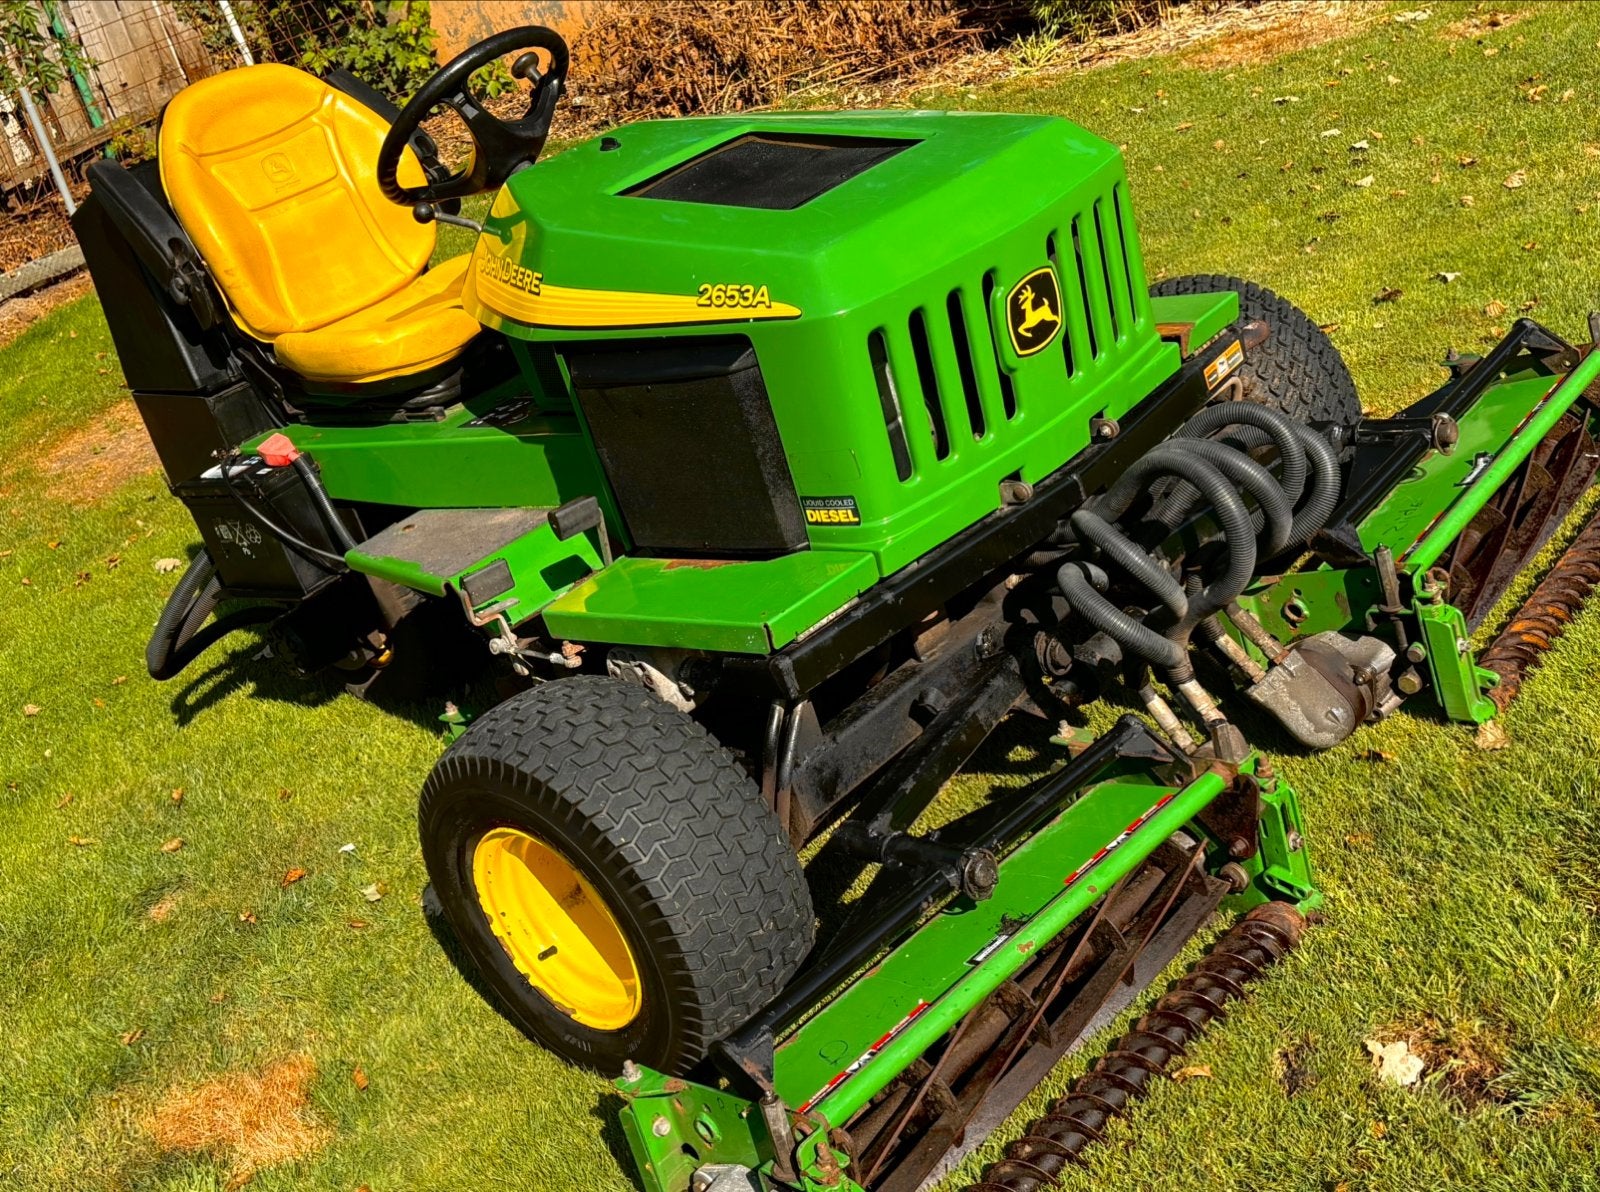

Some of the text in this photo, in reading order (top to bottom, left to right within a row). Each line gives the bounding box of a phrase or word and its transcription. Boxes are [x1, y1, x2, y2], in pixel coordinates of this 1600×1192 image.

[501, 257, 543, 296] DEERE
[697, 283, 771, 308] 2653A
[825, 499, 854, 507] COOLED
[805, 509, 859, 523] DIESEL
